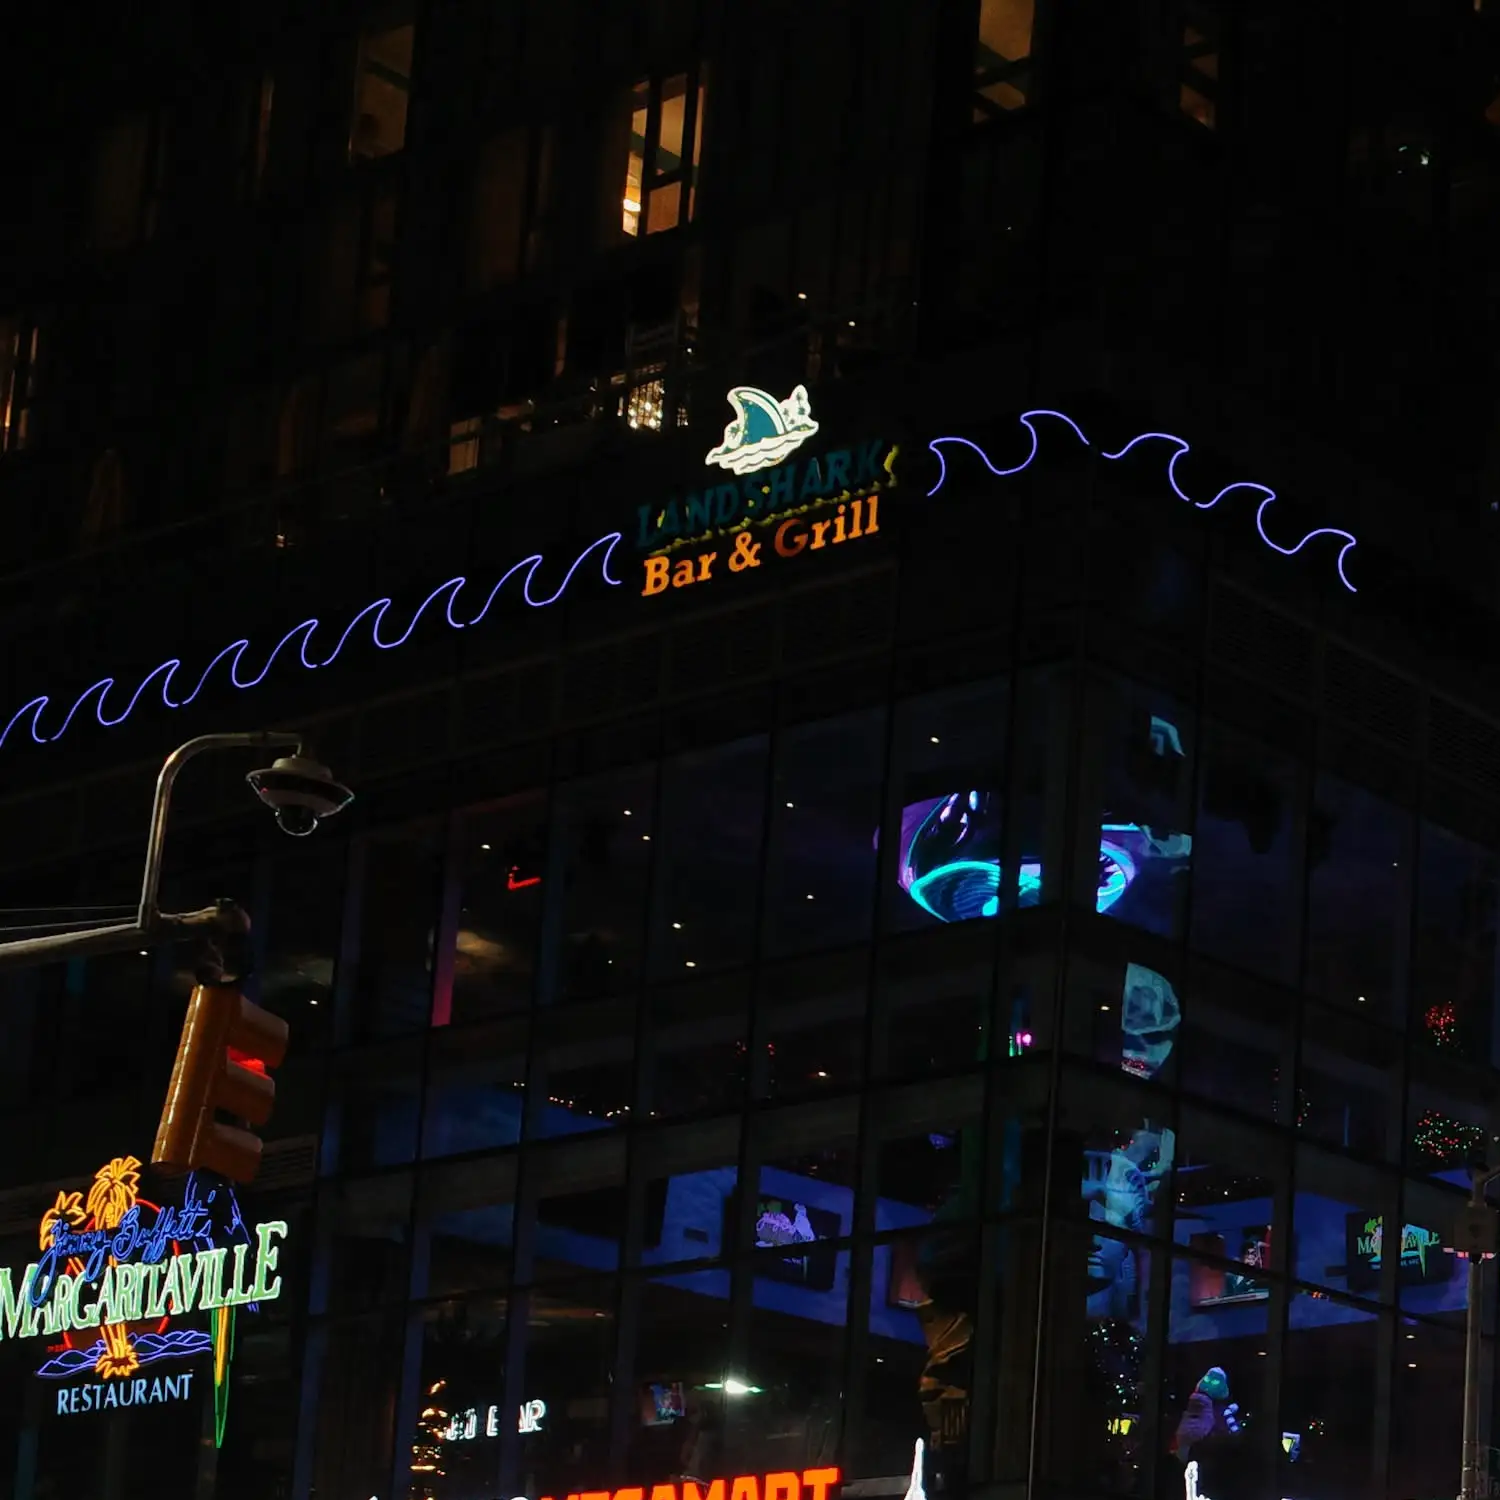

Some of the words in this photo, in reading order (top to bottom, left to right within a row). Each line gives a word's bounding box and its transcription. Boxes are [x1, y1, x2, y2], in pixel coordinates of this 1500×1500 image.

[641, 551, 717, 597] Bar
[728, 532, 761, 573] &
[774, 496, 879, 558] Grill
[0, 1220, 288, 1341] MARGARITAVILLE
[58, 1373, 194, 1416] RESTAURANT
